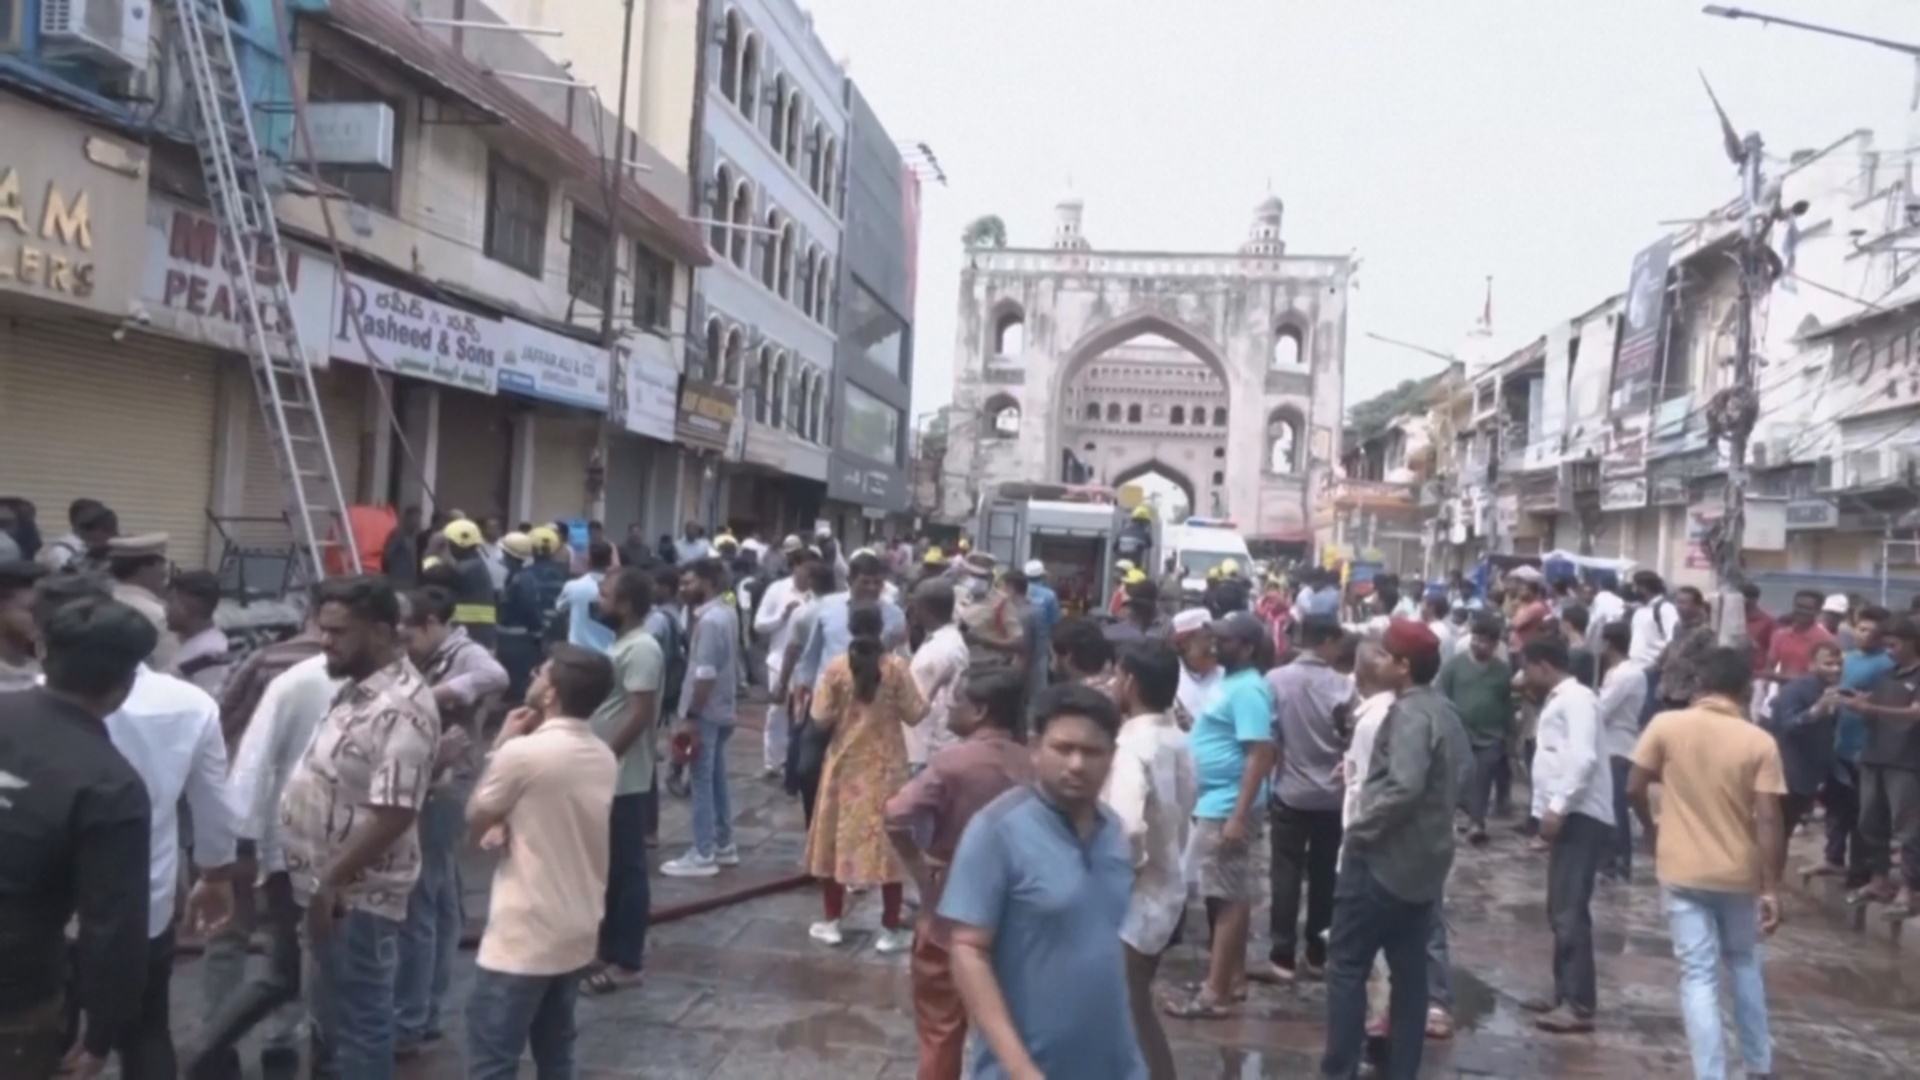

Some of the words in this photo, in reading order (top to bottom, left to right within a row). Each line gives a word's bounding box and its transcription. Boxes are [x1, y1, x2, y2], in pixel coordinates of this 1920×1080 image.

[336, 281, 432, 366] Rasheed
[437, 331, 450, 356] &
[456, 335, 495, 367] Sons
